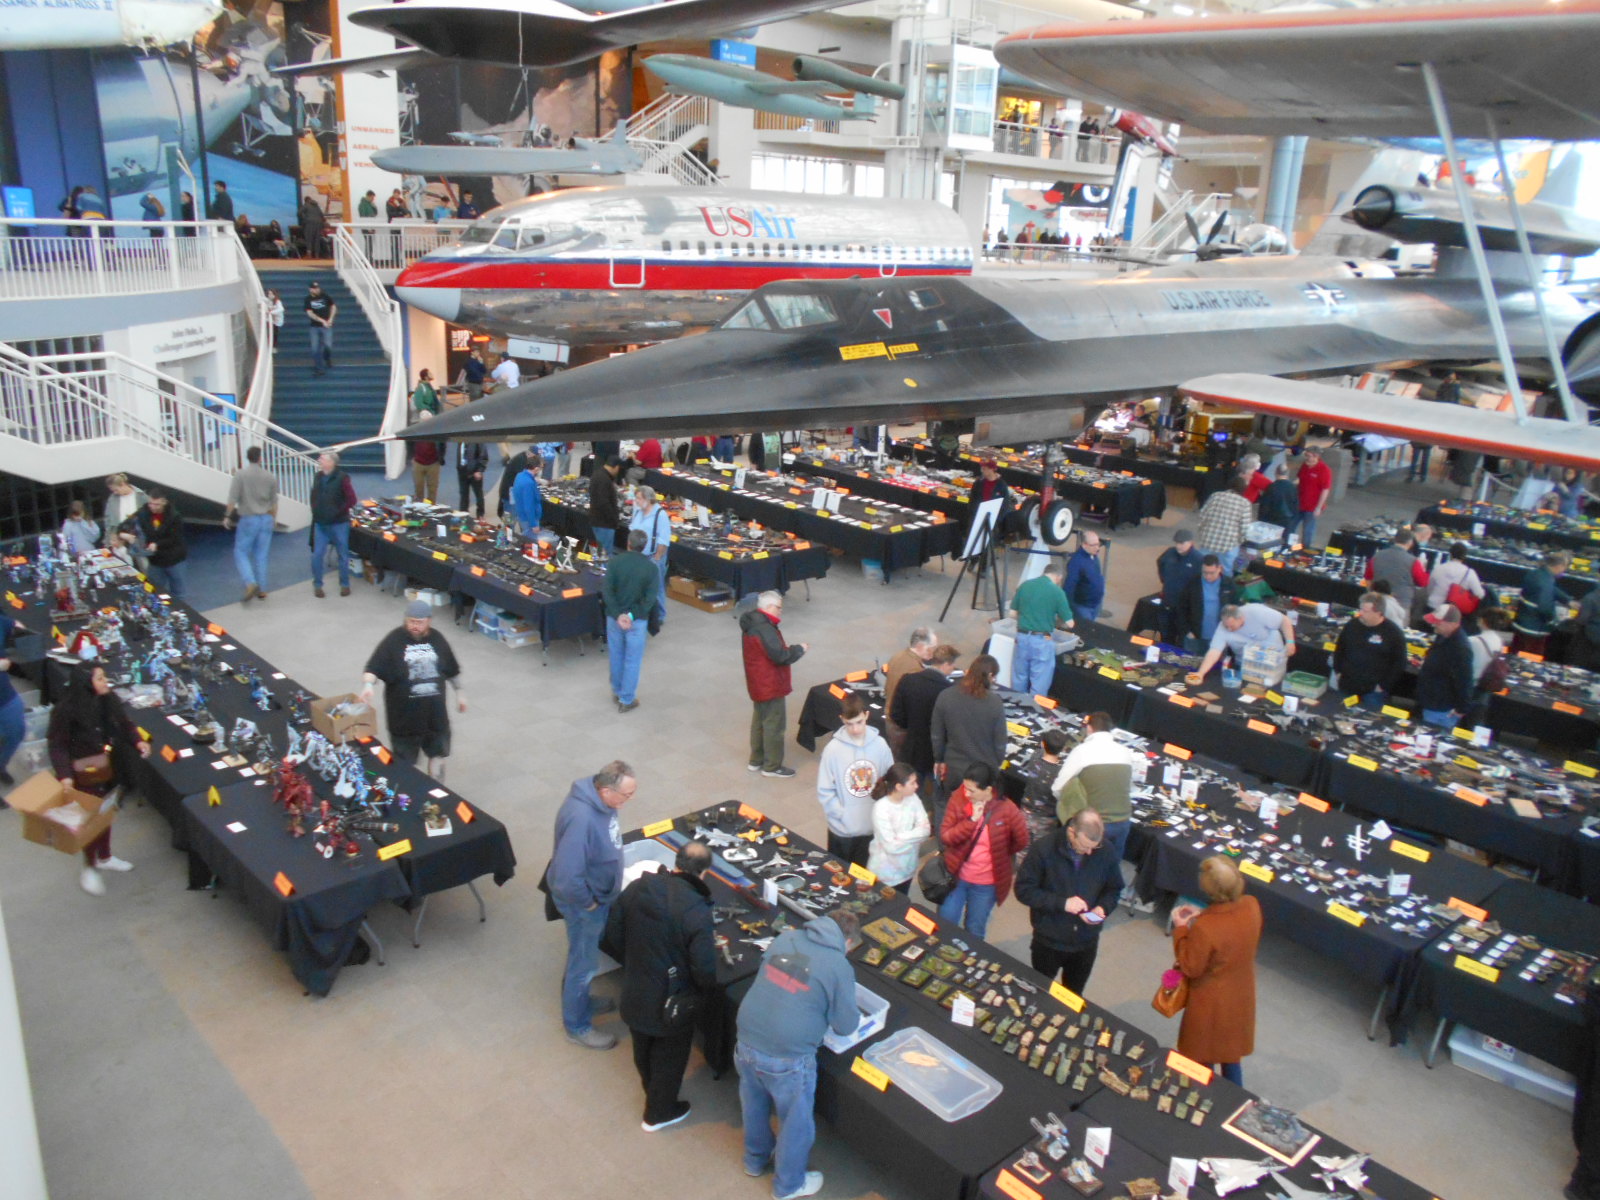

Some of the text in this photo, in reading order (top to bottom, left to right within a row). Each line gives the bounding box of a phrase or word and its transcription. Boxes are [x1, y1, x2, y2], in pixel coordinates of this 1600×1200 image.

[351, 126, 396, 134] UNMANNED
[352, 143, 379, 151] AERIAL
[697, 205, 797, 239] USAir
[1216, 289, 1270, 308] FORCE
